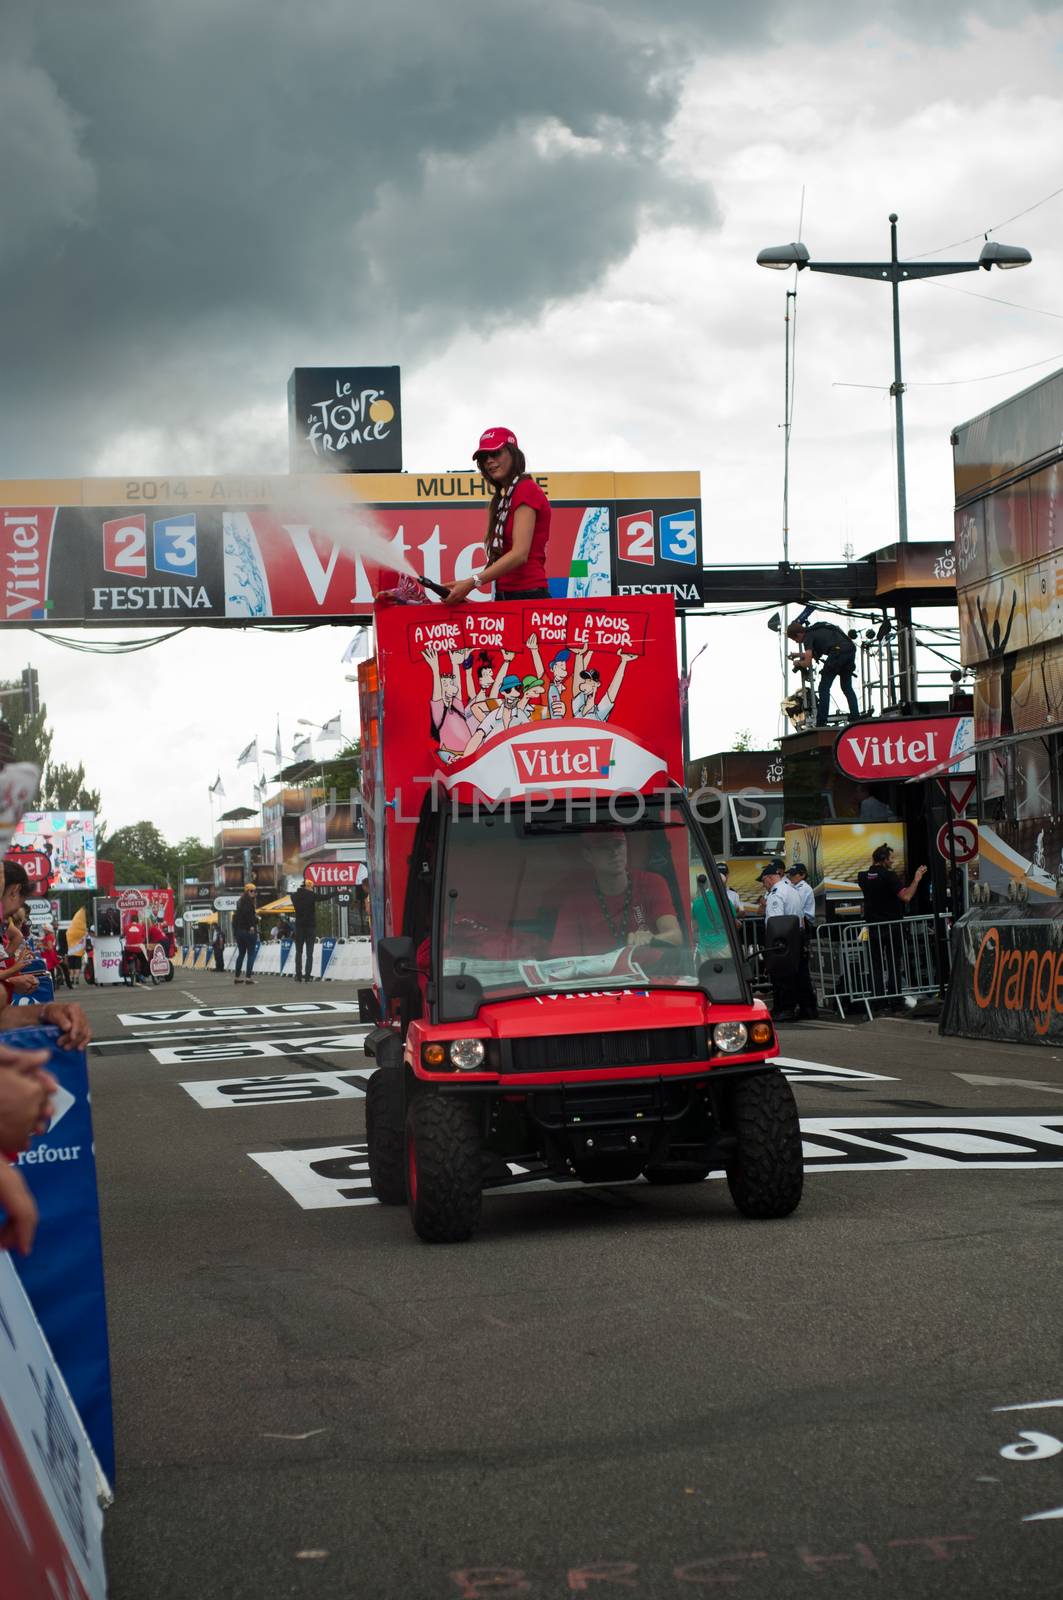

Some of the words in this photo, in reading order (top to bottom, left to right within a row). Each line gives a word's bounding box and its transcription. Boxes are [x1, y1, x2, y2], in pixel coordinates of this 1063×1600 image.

[126, 482, 188, 500] 2014
[416, 477, 549, 497] MULHE
[4, 513, 41, 618] Vittel
[92, 587, 212, 610] FESTINA
[466, 615, 474, 630] A
[477, 617, 504, 631] TON
[531, 612, 540, 625] A
[584, 614, 593, 628] A
[595, 615, 630, 631] VOUS
[415, 627, 423, 642] A
[425, 624, 460, 639] VOTRE
[469, 633, 503, 646] TOUR
[574, 628, 590, 643] LE
[595, 630, 632, 647] TOUR
[424, 637, 457, 652] TOUR
[847, 732, 938, 767] Vittel
[517, 746, 600, 777] Vittel
[310, 865, 353, 882] Vittel
[16, 1143, 81, 1167] refour
